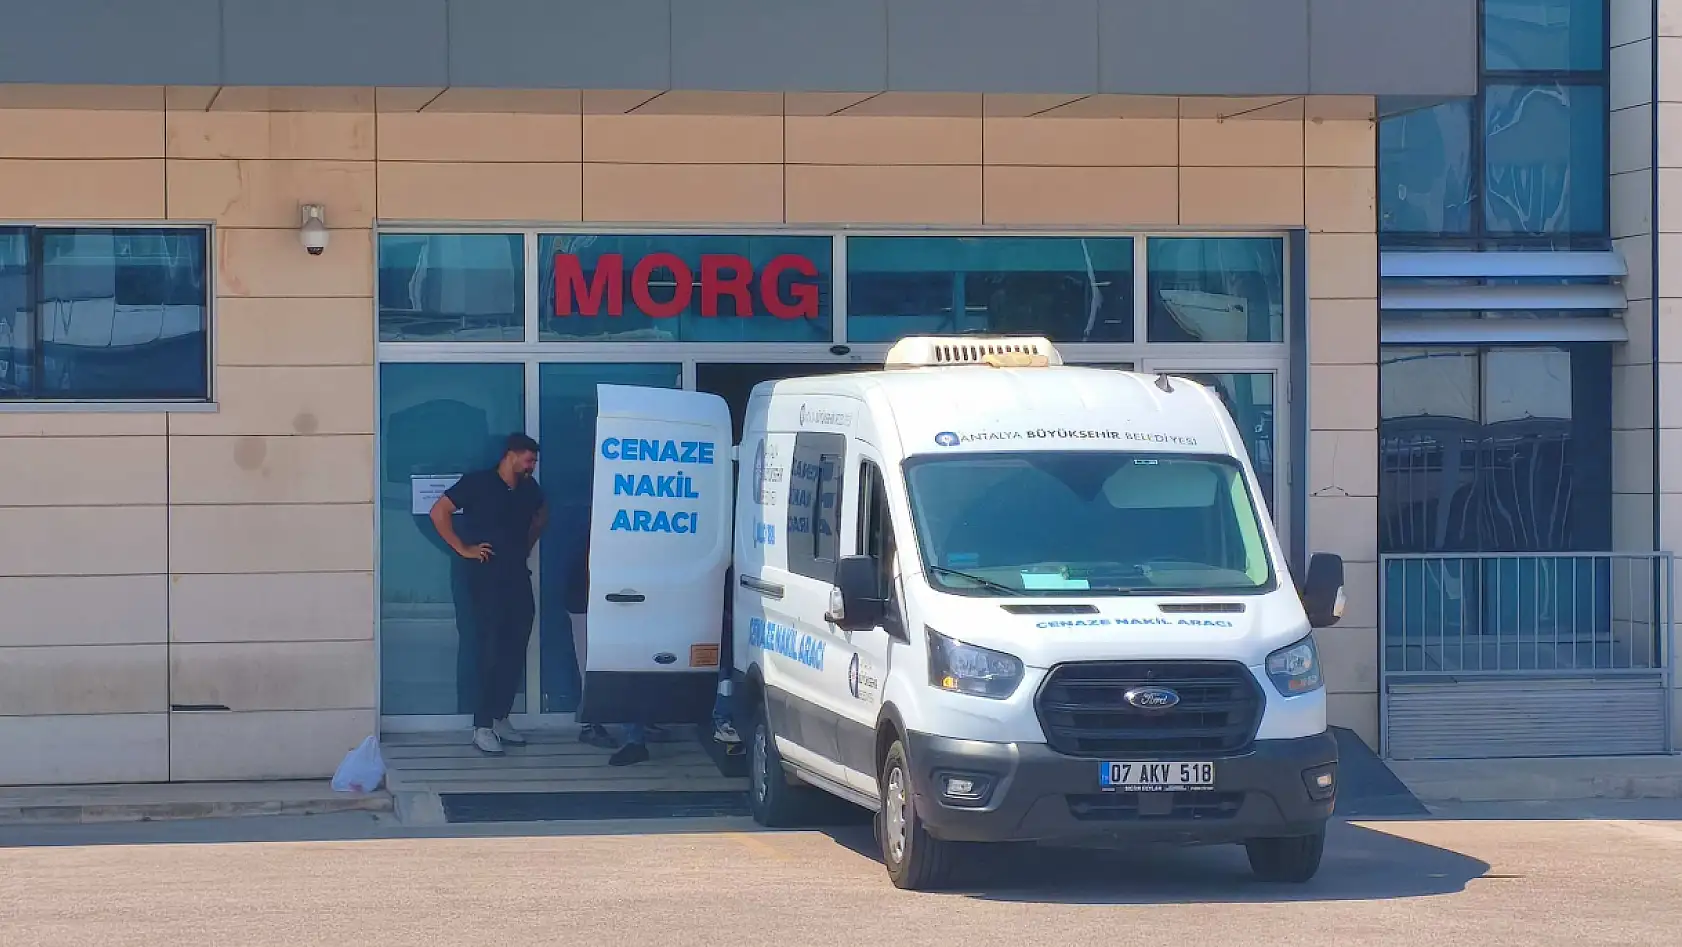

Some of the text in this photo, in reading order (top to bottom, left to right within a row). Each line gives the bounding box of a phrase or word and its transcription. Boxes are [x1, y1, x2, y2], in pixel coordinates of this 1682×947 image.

[554, 252, 819, 320] MORG
[960, 431, 1023, 443] ANTALYA
[601, 437, 715, 465] CENAZE
[613, 470, 700, 499] NAKİL
[609, 508, 699, 534] ARACI
[1035, 617, 1233, 629] CENAZE NAKİL ARACI
[1140, 691, 1168, 705] Ford
[1111, 764, 1131, 782] 07
[1140, 764, 1170, 782] AKV
[1180, 764, 1212, 782] 518
